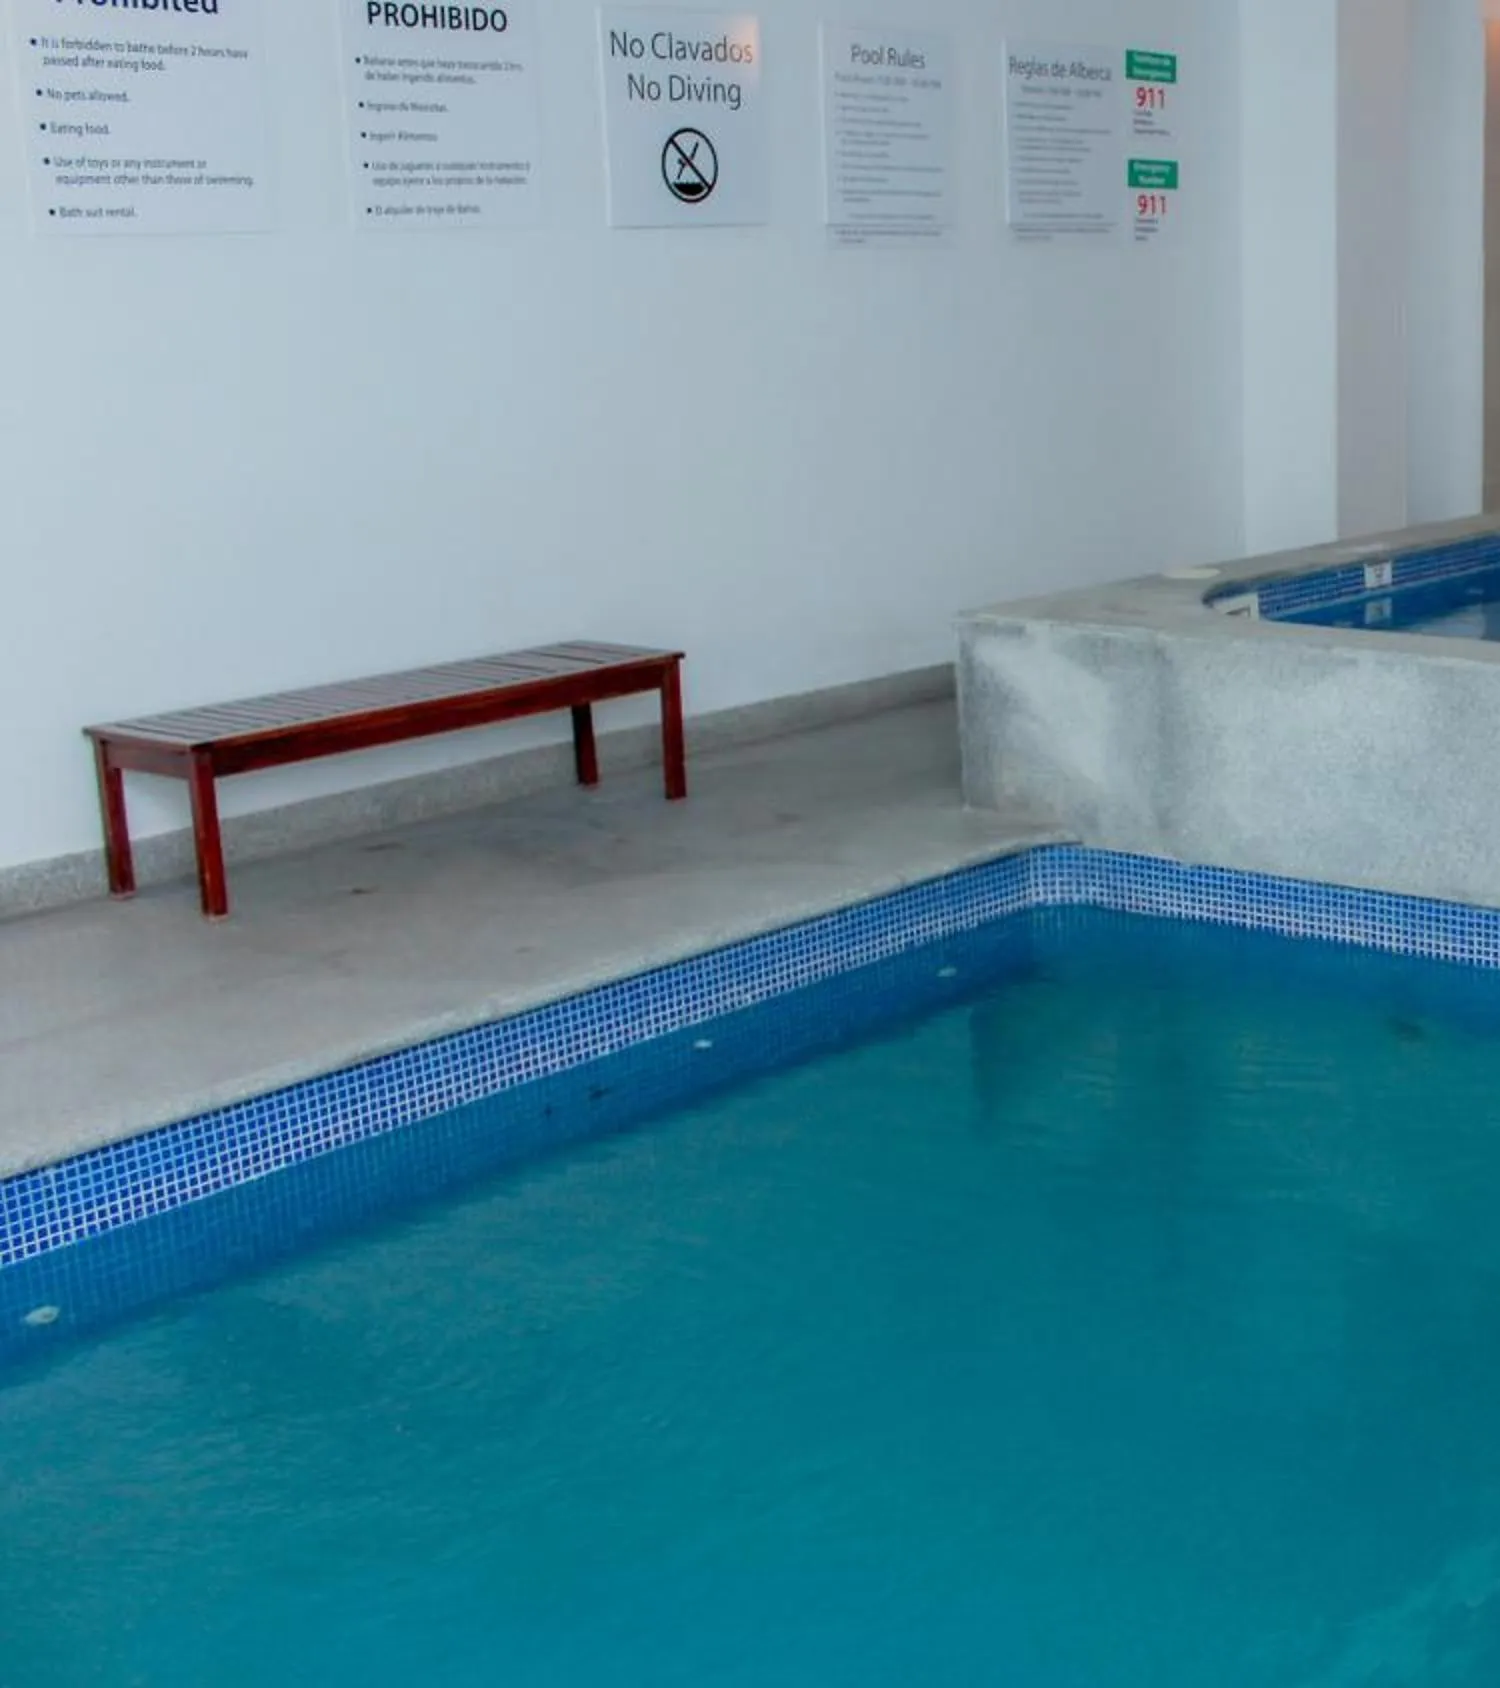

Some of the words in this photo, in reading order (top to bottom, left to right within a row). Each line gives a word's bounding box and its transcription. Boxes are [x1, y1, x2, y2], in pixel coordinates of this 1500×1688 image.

[366, 1, 507, 32] PROHIBIDO
[61, 37, 113, 52] forbidden
[609, 30, 645, 58] No
[651, 32, 753, 63] Clavados
[851, 43, 884, 65] Pool
[887, 47, 926, 69] Rules
[1009, 56, 1050, 80] Reglas
[1051, 61, 1065, 79] de
[1069, 61, 1112, 82] Alberca
[47, 88, 62, 100] No
[627, 73, 661, 101] No
[668, 74, 742, 111] Diving
[1136, 86, 1165, 109] 911
[50, 122, 83, 137] Eating
[1137, 194, 1166, 216] 911
